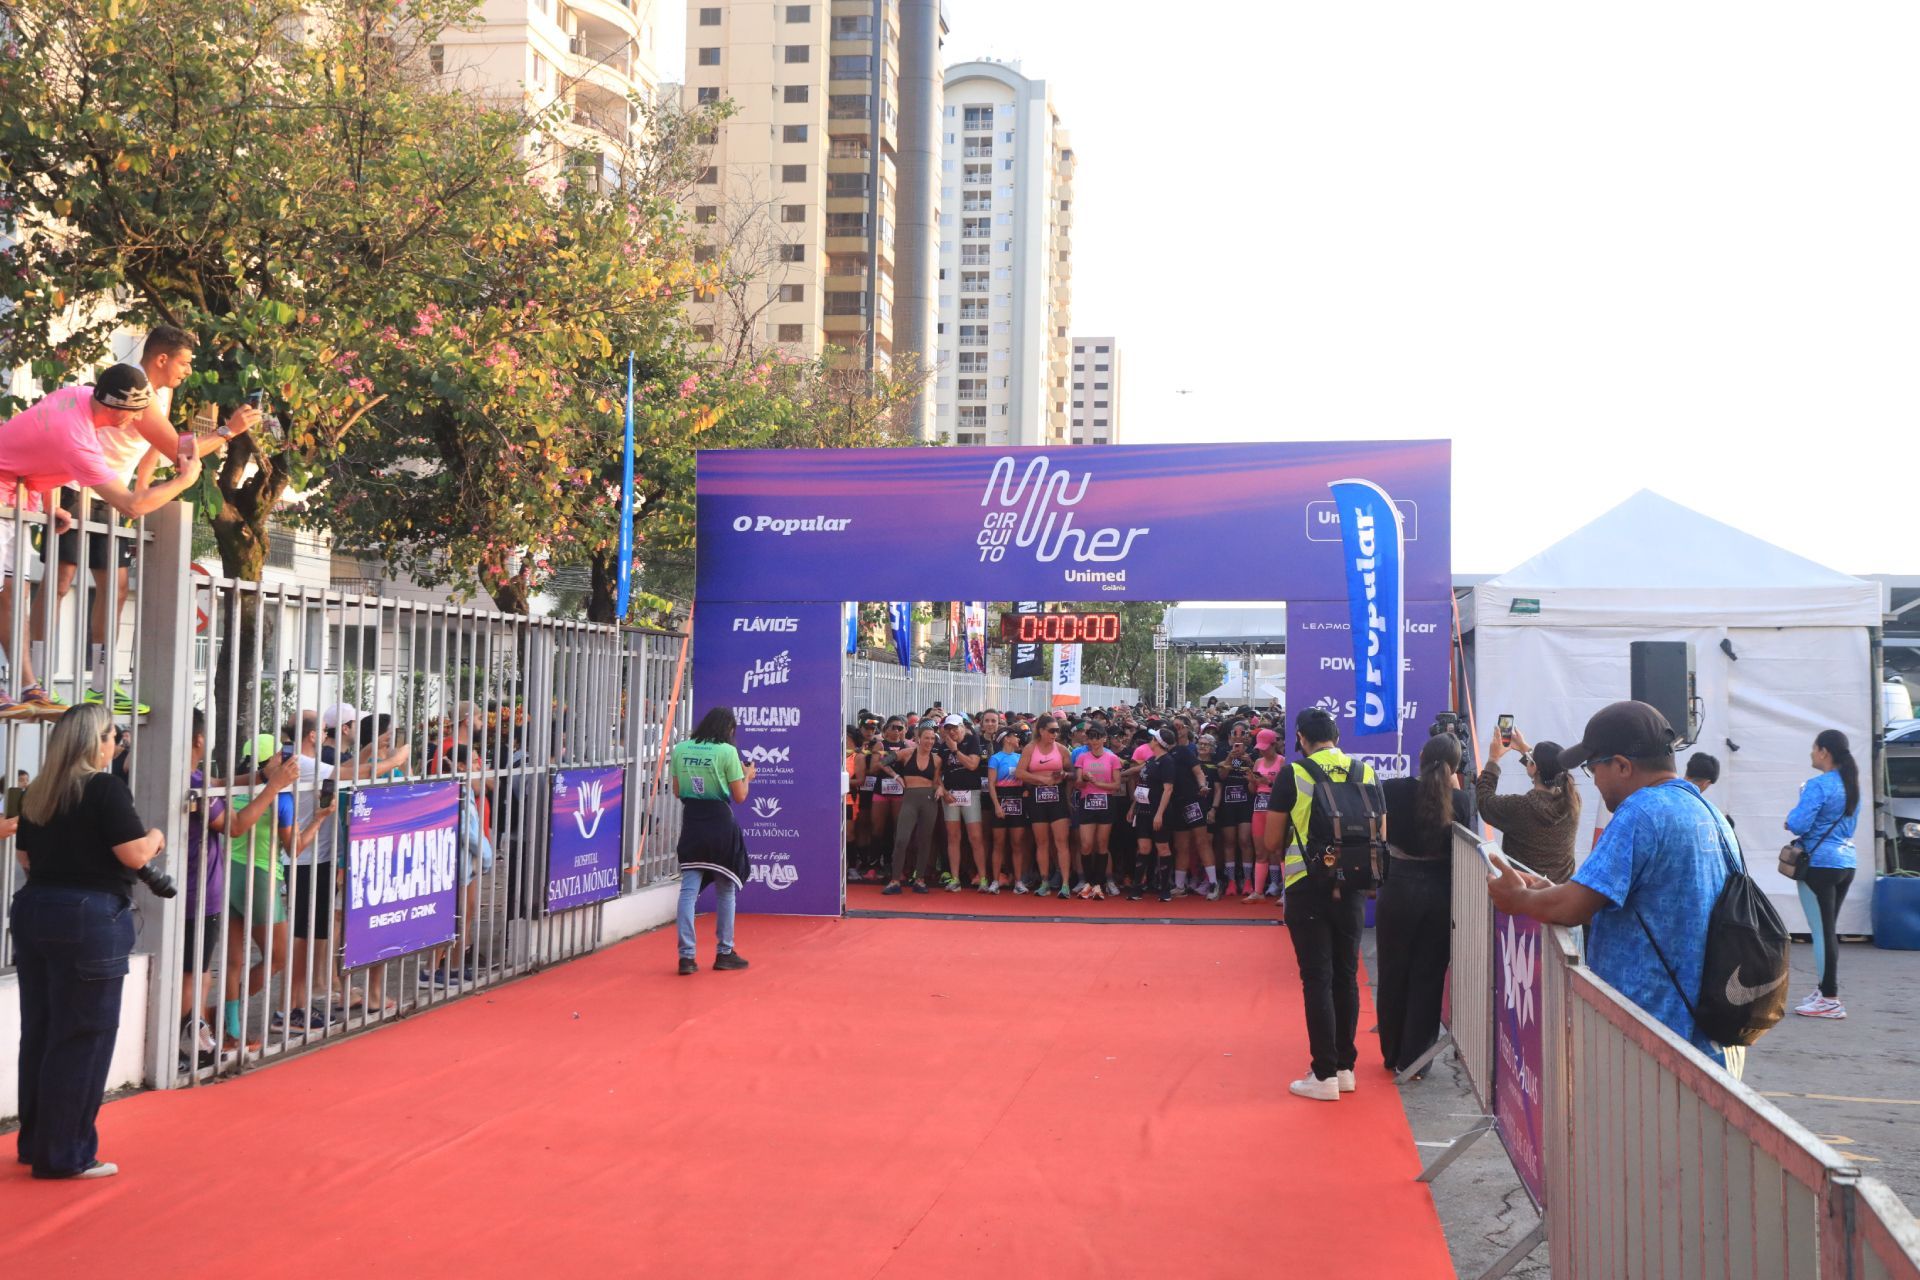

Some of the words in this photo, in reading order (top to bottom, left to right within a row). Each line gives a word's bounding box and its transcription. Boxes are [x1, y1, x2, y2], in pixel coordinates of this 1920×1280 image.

[733, 516, 752, 532] O
[754, 516, 851, 536] Popular
[1064, 569, 1126, 582] Unimed
[1102, 584, 1126, 592] Goiânia
[1020, 615, 1118, 641] 0:00:00
[756, 659, 775, 674] La
[742, 667, 790, 694] fruit
[732, 706, 800, 727] VULCANO
[682, 757, 712, 767] TRI-Z
[775, 765, 794, 774] ÁGUAS
[743, 828, 761, 837] NTA
[763, 826, 800, 838] MÔNICA
[350, 826, 457, 910] VULCANO
[574, 852, 598, 868] HOSPITAL
[548, 875, 581, 901] SANTA
[583, 866, 618, 894] MÔNICA
[369, 909, 408, 929] ENERGY
[410, 902, 436, 920] DRINK
